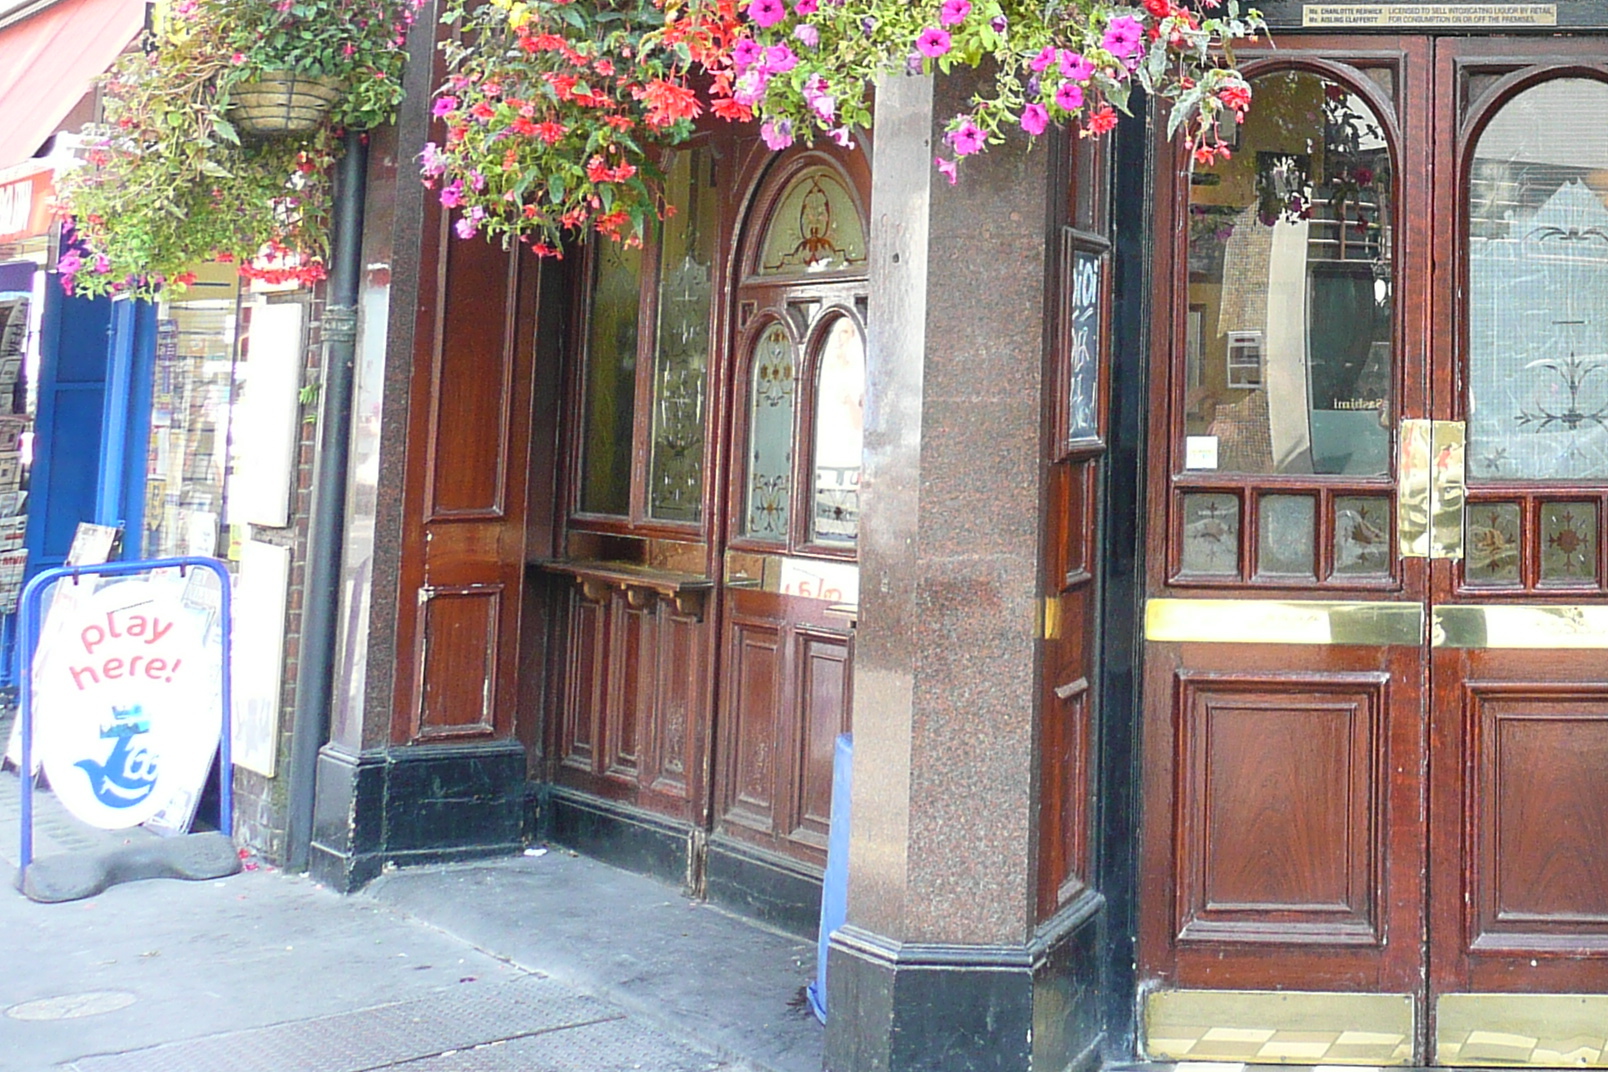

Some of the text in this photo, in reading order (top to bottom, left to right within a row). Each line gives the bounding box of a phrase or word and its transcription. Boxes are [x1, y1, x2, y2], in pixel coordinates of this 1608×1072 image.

[1388, 7, 1420, 15] LICENSED
[1421, 7, 1430, 15] TO
[1432, 7, 1447, 15] SELL
[1448, 7, 1493, 15] INTOXICATING
[81, 611, 174, 654] play
